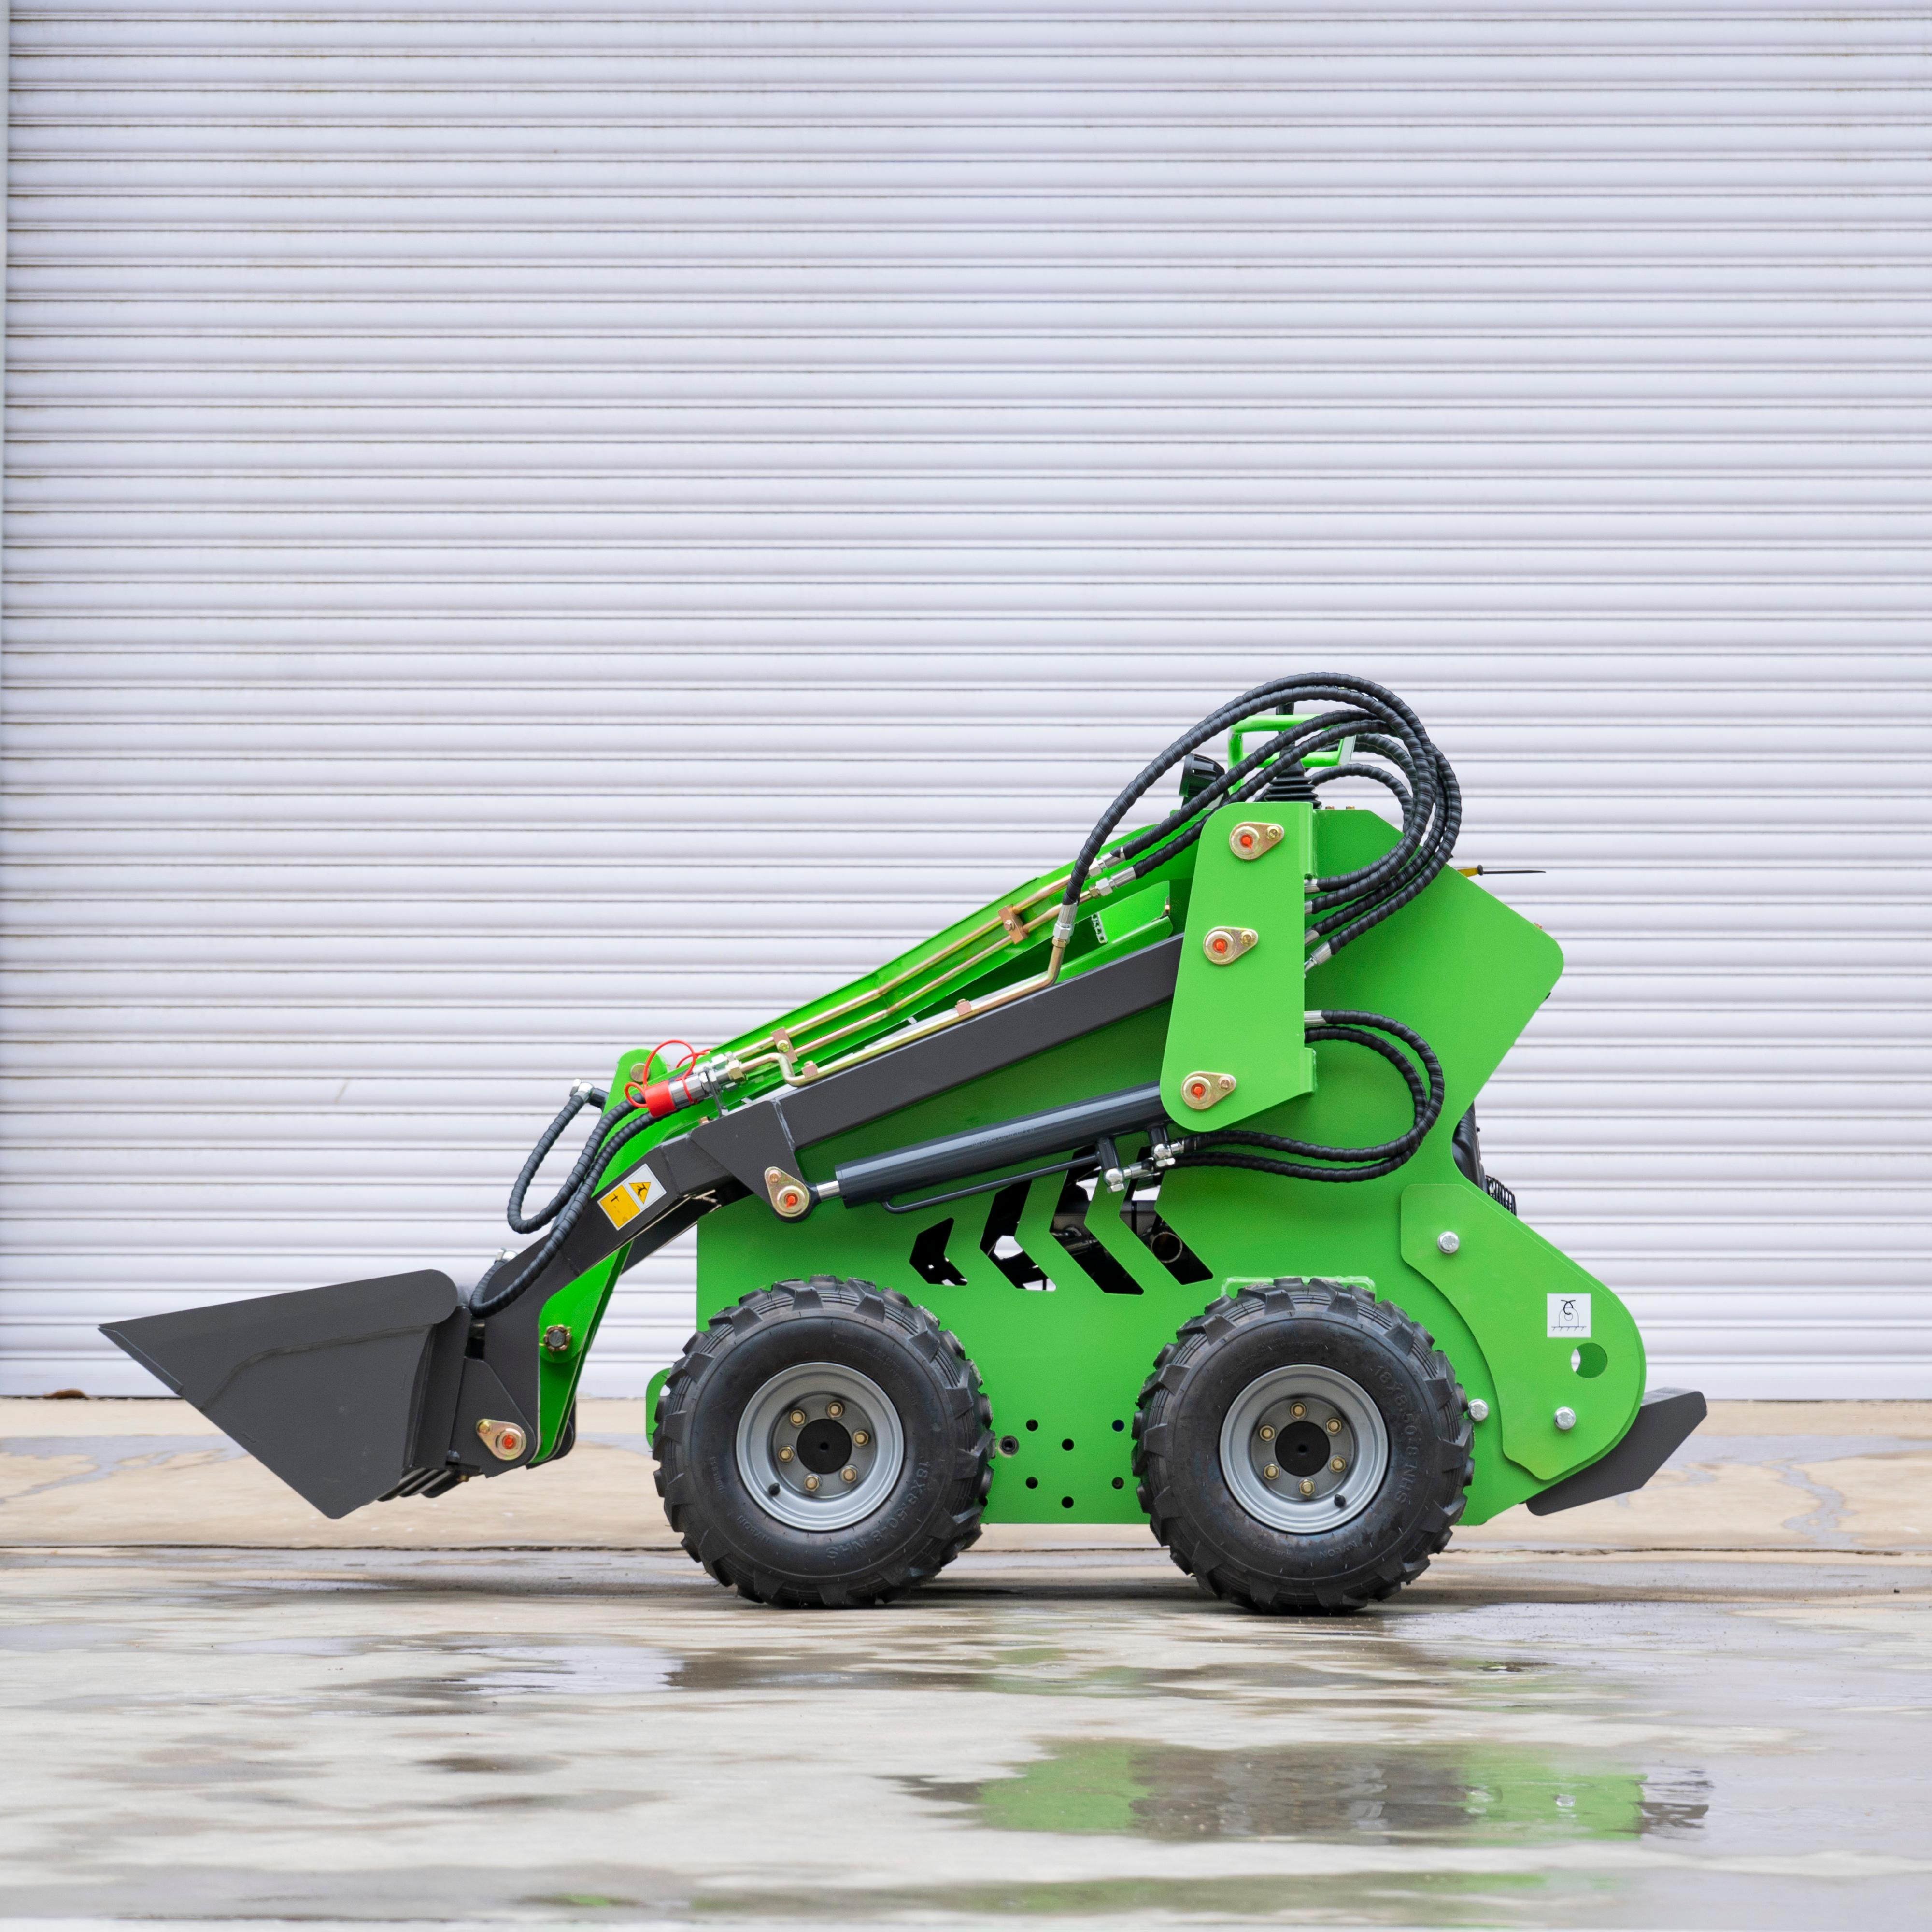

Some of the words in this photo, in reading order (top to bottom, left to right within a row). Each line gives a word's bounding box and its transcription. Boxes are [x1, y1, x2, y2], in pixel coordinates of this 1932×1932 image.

[1396, 1463, 1417, 1504] NHS
[827, 1539, 866, 1559] NHS
[1320, 1541, 1358, 1558] NYLON
